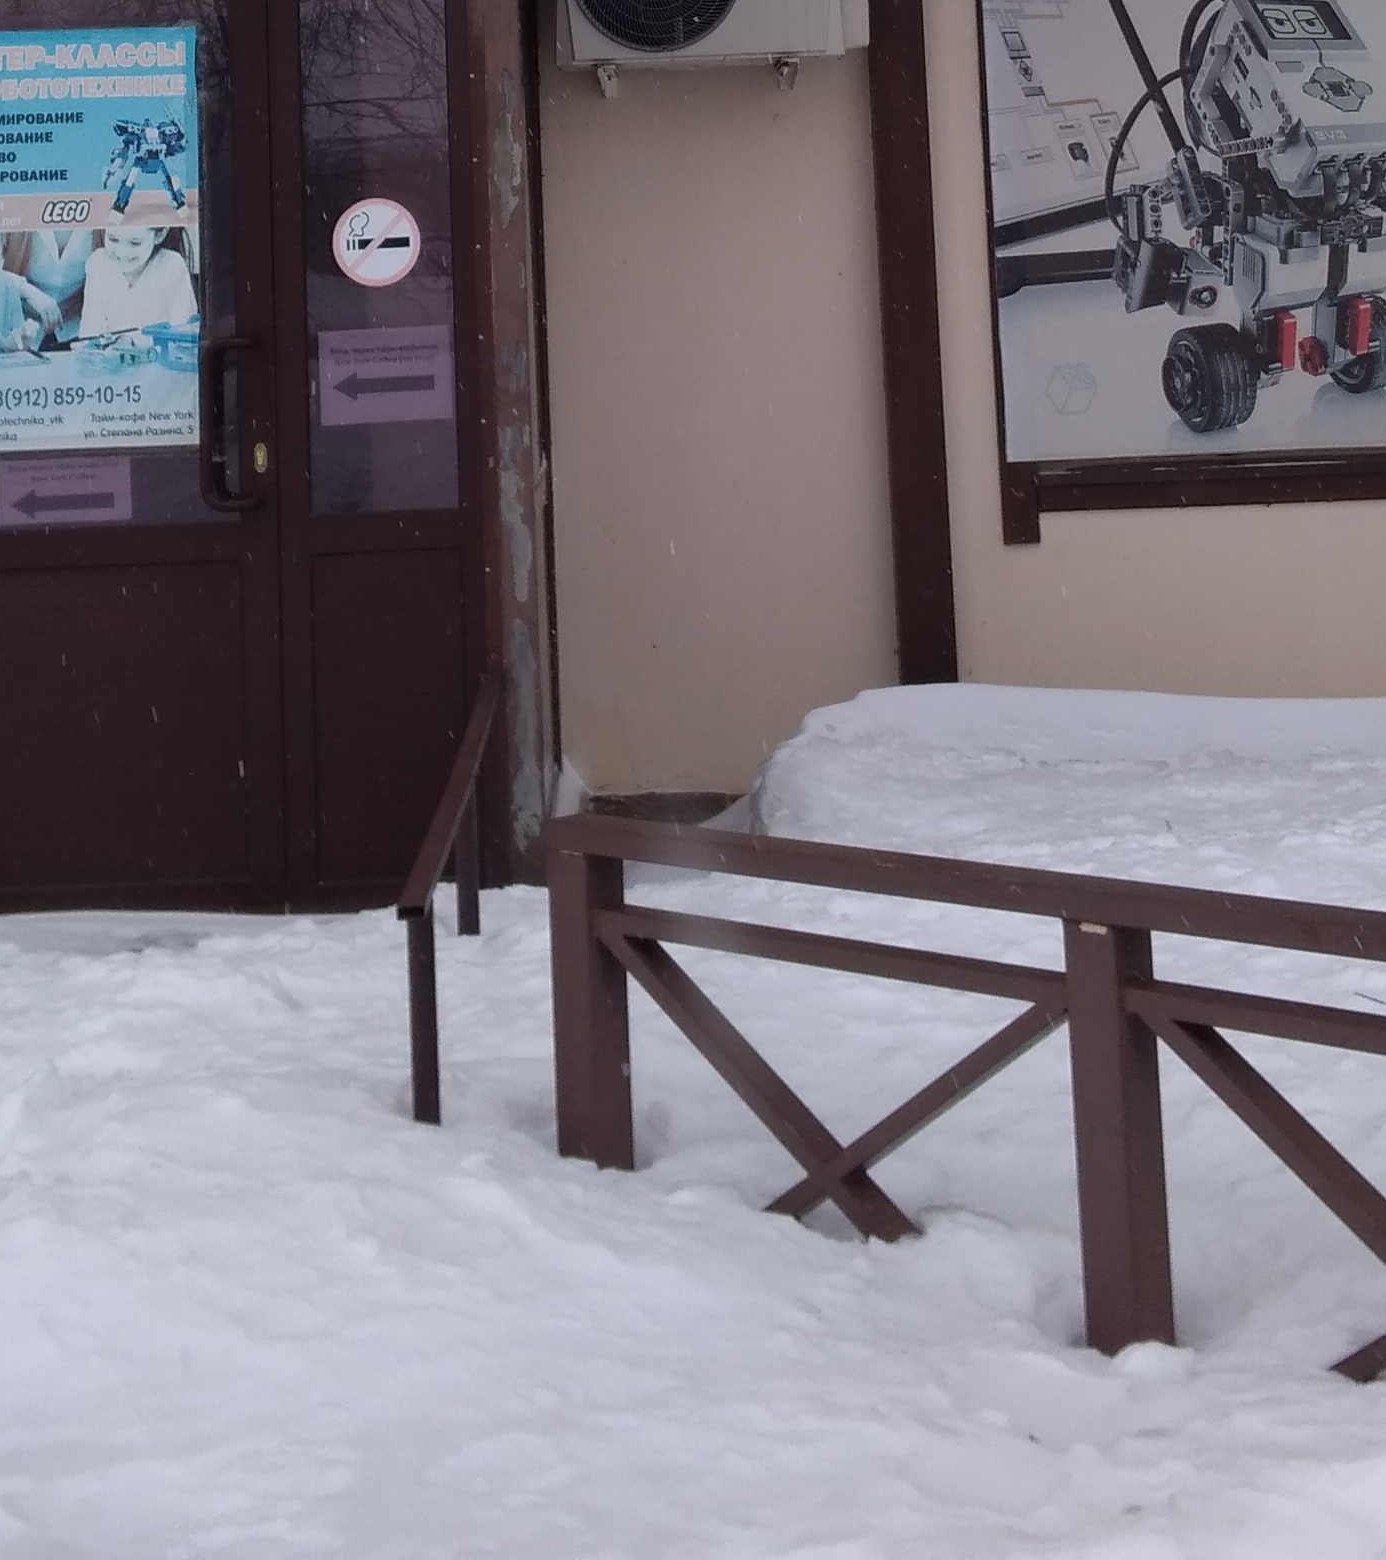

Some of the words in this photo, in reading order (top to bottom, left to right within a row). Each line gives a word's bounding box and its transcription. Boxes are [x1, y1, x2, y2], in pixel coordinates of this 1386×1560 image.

[41, 200, 92, 224] LEGO
[53, 385, 142, 405] 859-10-15
[149, 411, 171, 421] New
[173, 410, 194, 420] York
[100, 428, 143, 438] Степана
